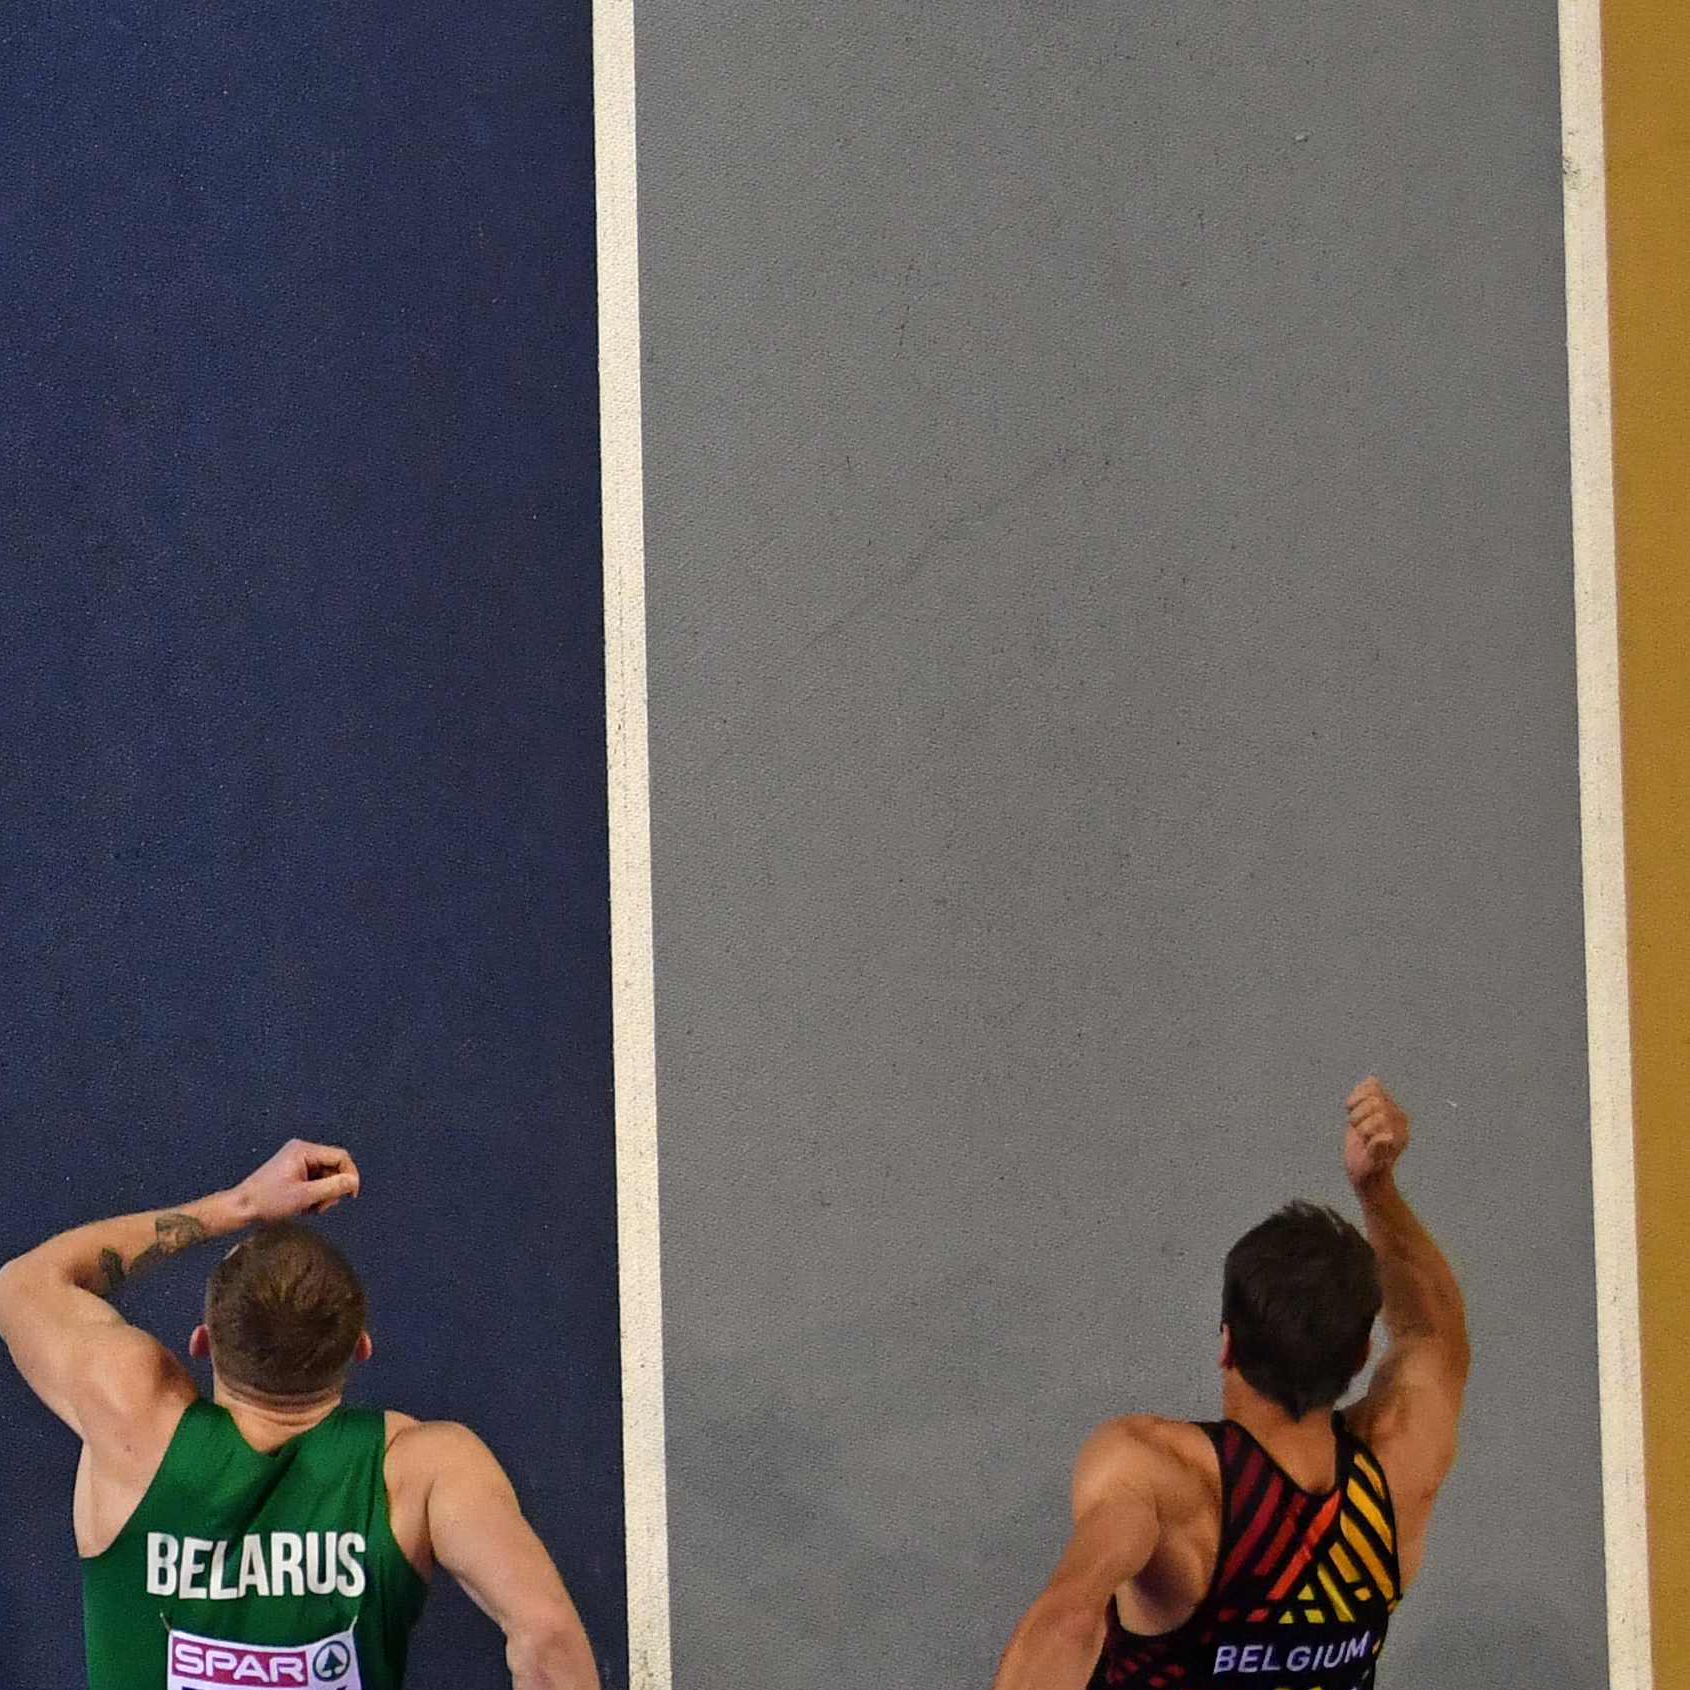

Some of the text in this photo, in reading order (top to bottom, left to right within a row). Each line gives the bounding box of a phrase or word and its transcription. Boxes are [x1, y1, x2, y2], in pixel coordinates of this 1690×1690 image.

[146, 1531, 366, 1600] BELARUS
[174, 1643, 304, 1683] SPAR
[1213, 1630, 1370, 1675] BELGIUM
